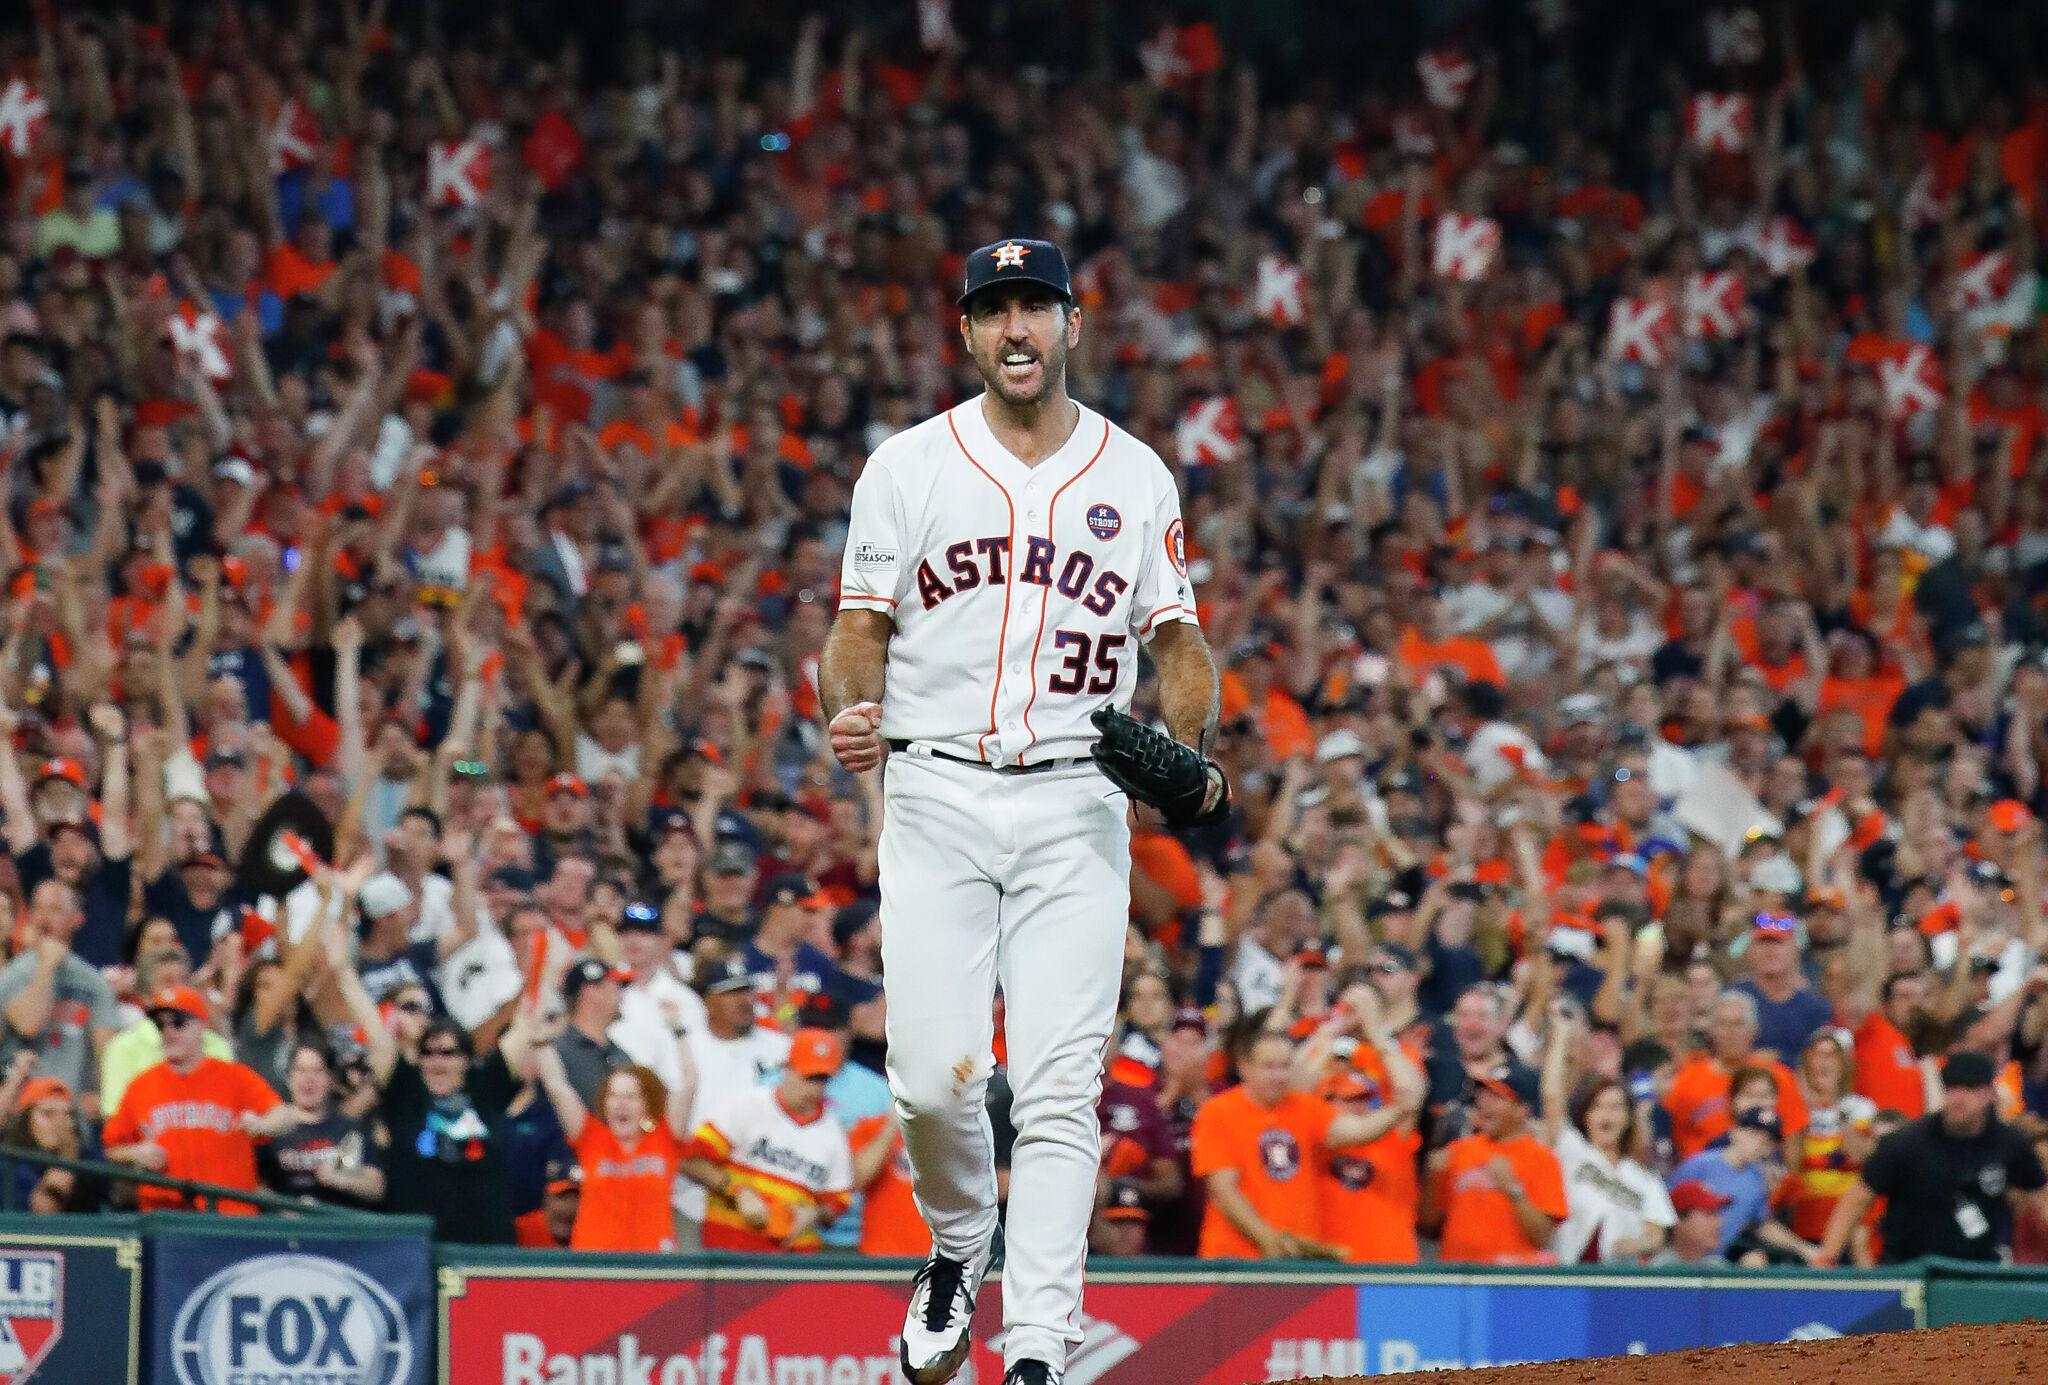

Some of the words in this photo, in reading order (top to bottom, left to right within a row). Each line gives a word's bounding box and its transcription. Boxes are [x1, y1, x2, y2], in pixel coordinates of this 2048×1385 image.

[1697, 92, 1747, 153] K
[425, 142, 484, 206] K
[996, 245, 1024, 267] H
[1434, 213, 1499, 281] K
[1255, 256, 1304, 322] K
[1688, 273, 1745, 338] K
[1607, 297, 1666, 368] K
[1882, 343, 1946, 412] K
[1175, 397, 1238, 466] K
[1088, 516, 1119, 529] STRONG
[916, 535, 1129, 617] ASTROS
[1048, 629, 1128, 695] 35
[229, 1296, 358, 1368] FOX
[502, 1332, 658, 1385] Bank
[659, 1333, 729, 1385] of
[732, 1334, 979, 1385] Ameri
